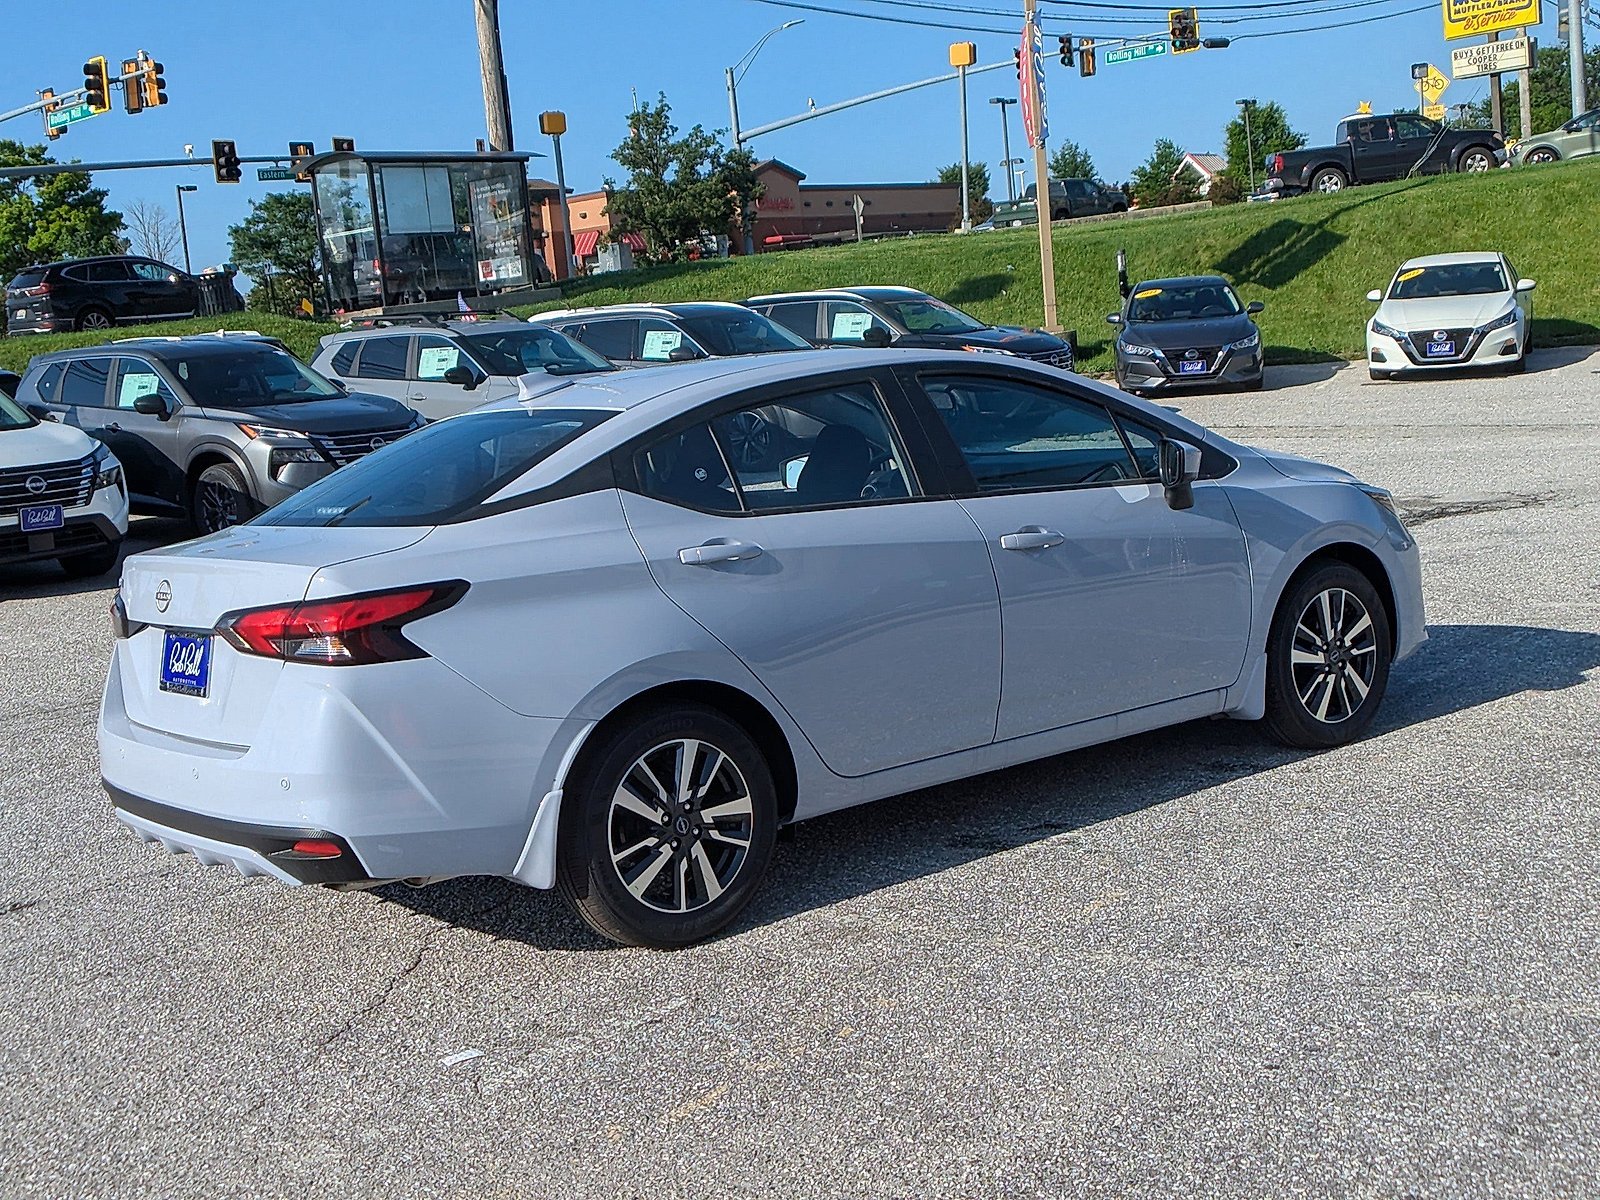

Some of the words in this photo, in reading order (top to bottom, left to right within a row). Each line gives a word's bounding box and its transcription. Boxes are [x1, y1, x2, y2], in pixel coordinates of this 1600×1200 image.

[1453, 0, 1526, 15] MUFFLER/BRA
[1108, 50, 1132, 61] Rolling
[1134, 46, 1146, 57] Mill
[1467, 54, 1498, 65] COOPER
[1477, 63, 1498, 72] TIRES
[260, 171, 285, 179] Eastern
[169, 641, 186, 674] Bob
[183, 642, 205, 677] Bell
